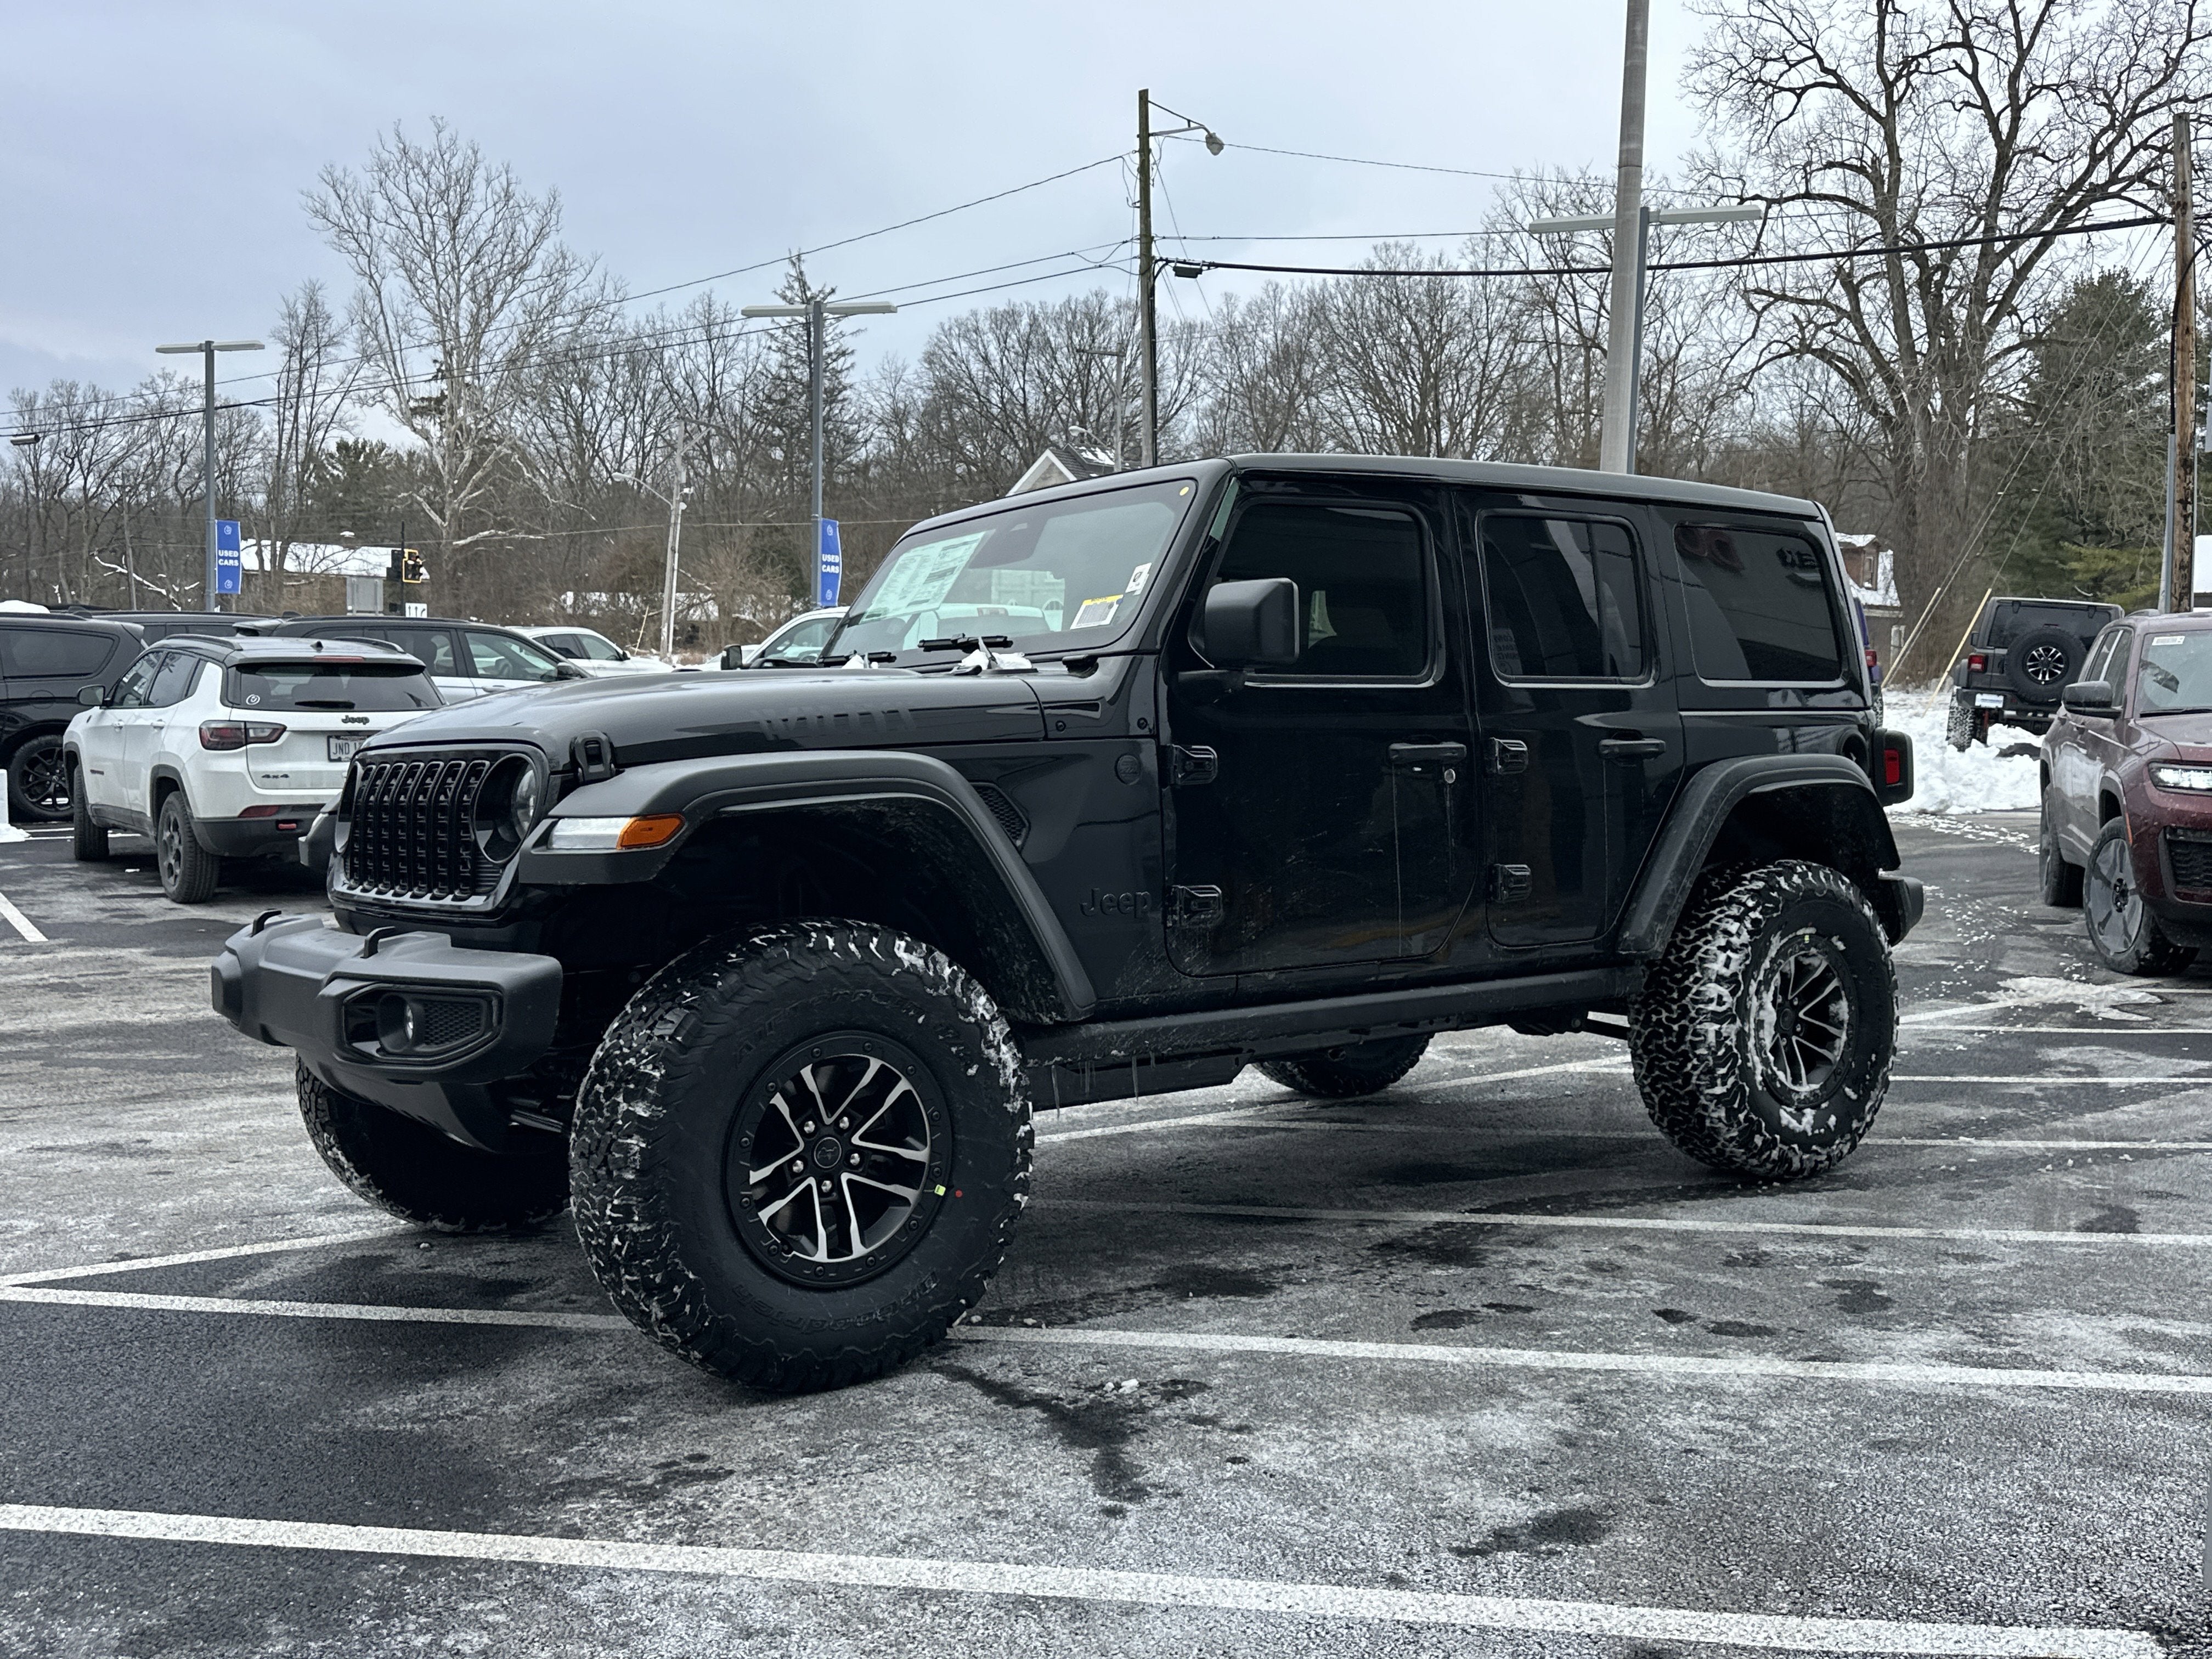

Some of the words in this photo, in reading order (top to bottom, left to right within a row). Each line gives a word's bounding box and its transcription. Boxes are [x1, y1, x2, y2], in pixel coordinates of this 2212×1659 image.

[822, 554, 839, 563] USED
[822, 565, 839, 574] CARS
[341, 715, 370, 725] Jeep
[333, 742, 349, 755] JND
[1080, 887, 1150, 919] Jeep
